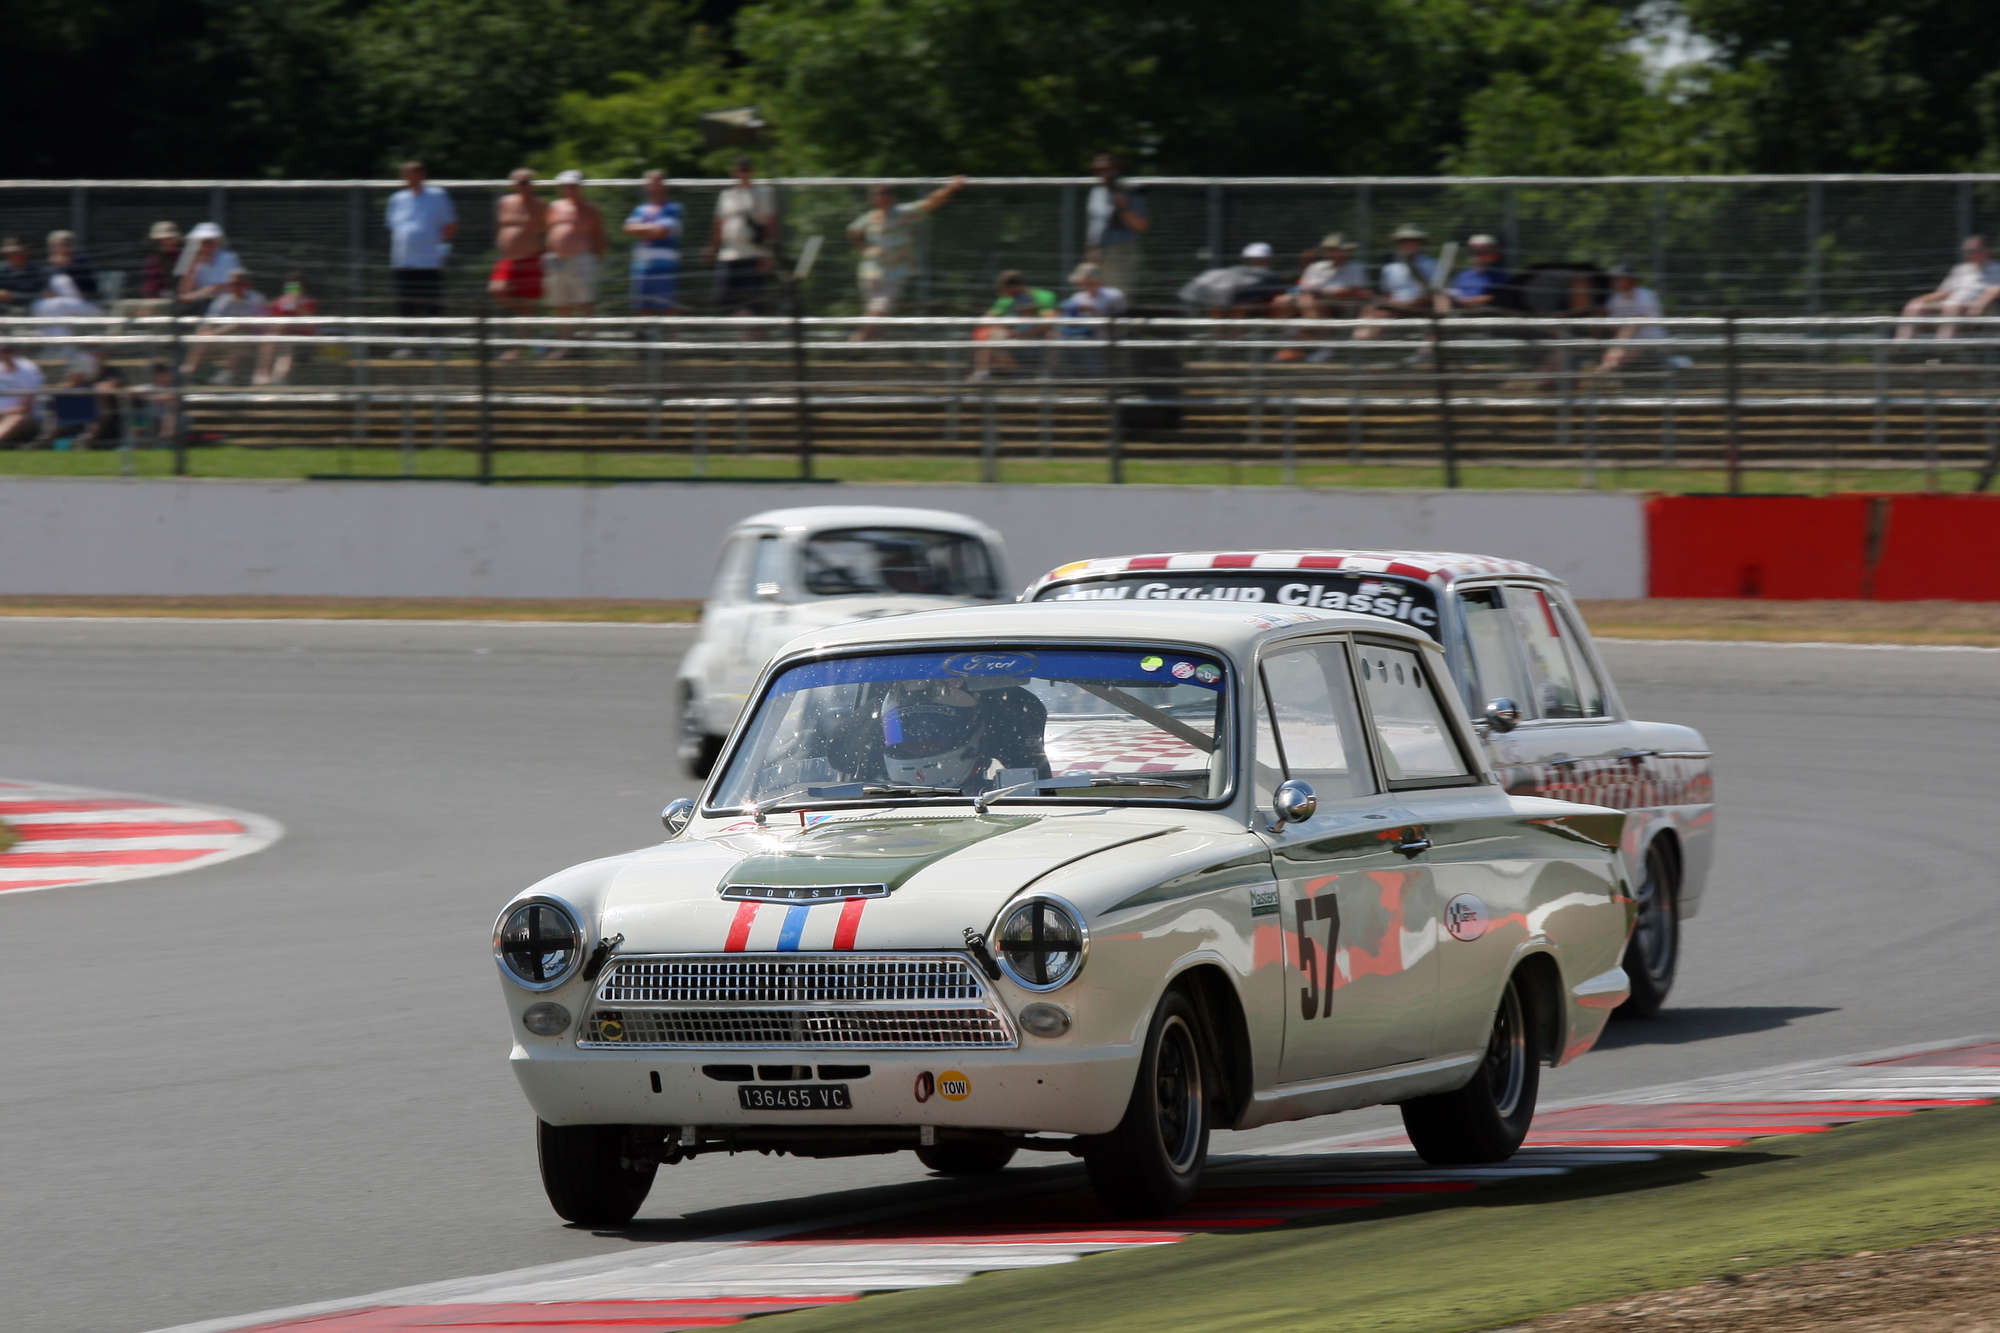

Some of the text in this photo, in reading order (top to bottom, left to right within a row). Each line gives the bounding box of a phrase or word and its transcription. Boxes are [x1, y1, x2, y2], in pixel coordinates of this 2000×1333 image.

[1276, 583, 1438, 627] Classic
[745, 887, 863, 898] CONSUL
[1295, 893, 1340, 1020] 57
[942, 1081, 966, 1095] TOW
[744, 1089, 844, 1107] 136465 VC
